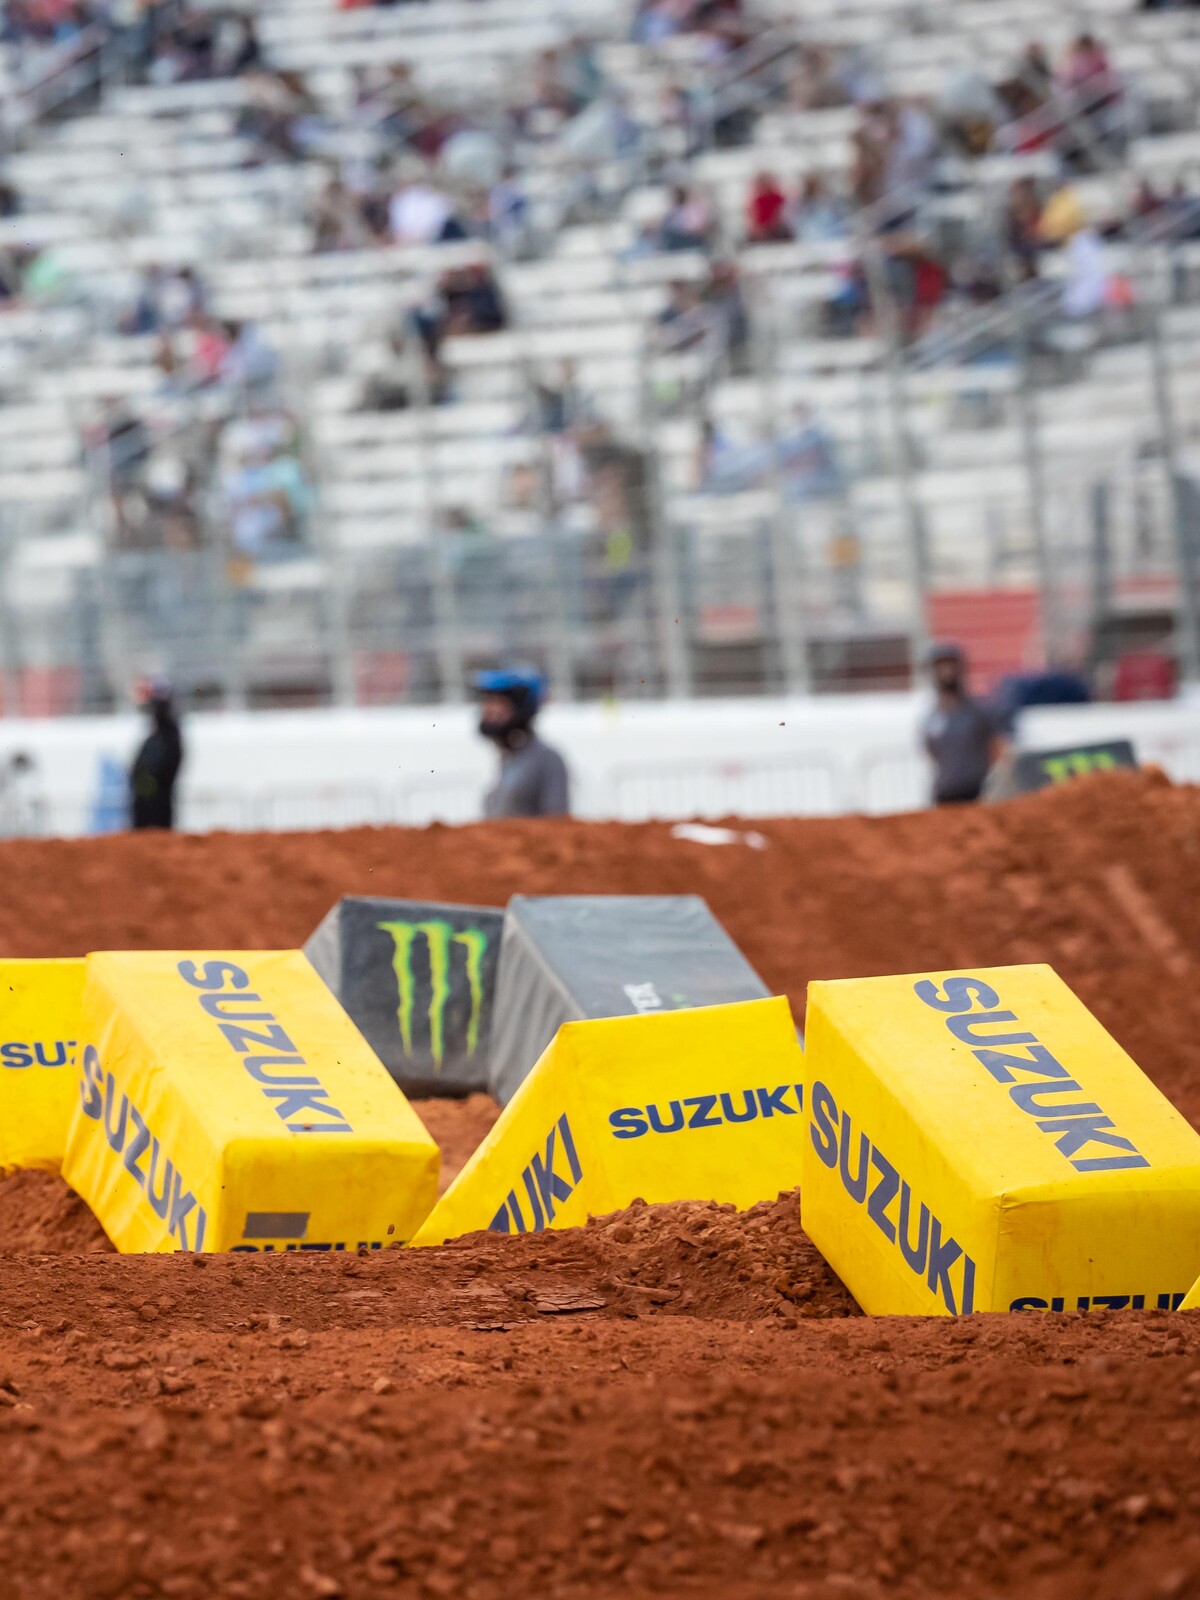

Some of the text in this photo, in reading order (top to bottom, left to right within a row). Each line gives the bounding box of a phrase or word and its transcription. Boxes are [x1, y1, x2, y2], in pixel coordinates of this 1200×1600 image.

[177, 960, 353, 1132] SUZUKI
[914, 977, 1151, 1172] SUZUKI
[80, 1044, 207, 1253] SUZUKI
[810, 1081, 976, 1316] SUZUKI
